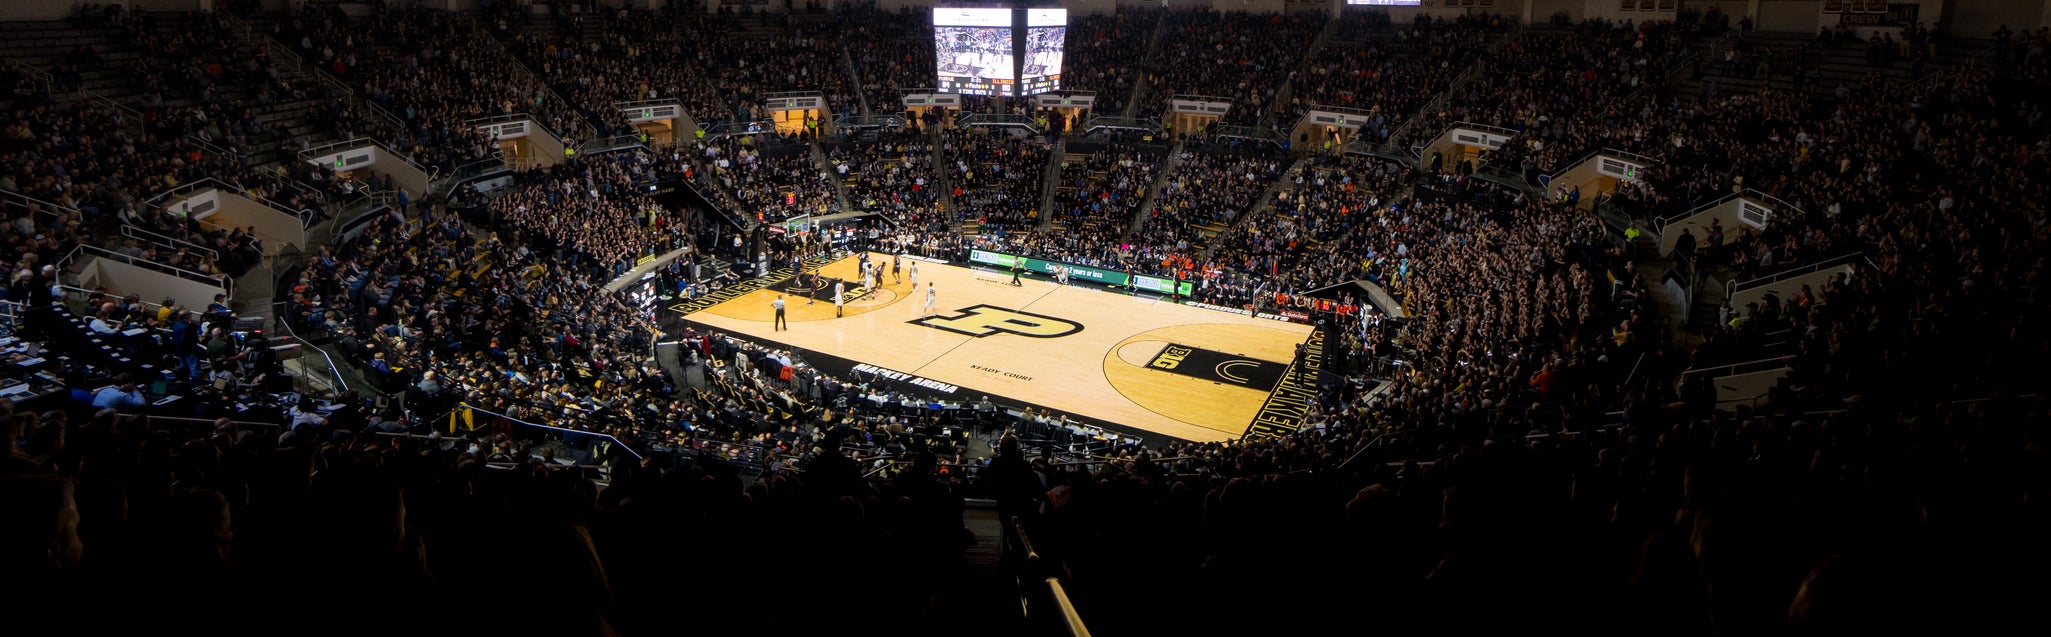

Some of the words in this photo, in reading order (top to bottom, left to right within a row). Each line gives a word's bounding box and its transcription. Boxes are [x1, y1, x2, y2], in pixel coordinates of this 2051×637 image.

[1073, 268, 1086, 276] years
[851, 363, 913, 381] MACKEY
[909, 377, 959, 394] ARENA
[970, 364, 1001, 374] KEADY
[1003, 371, 1034, 381] COURT
